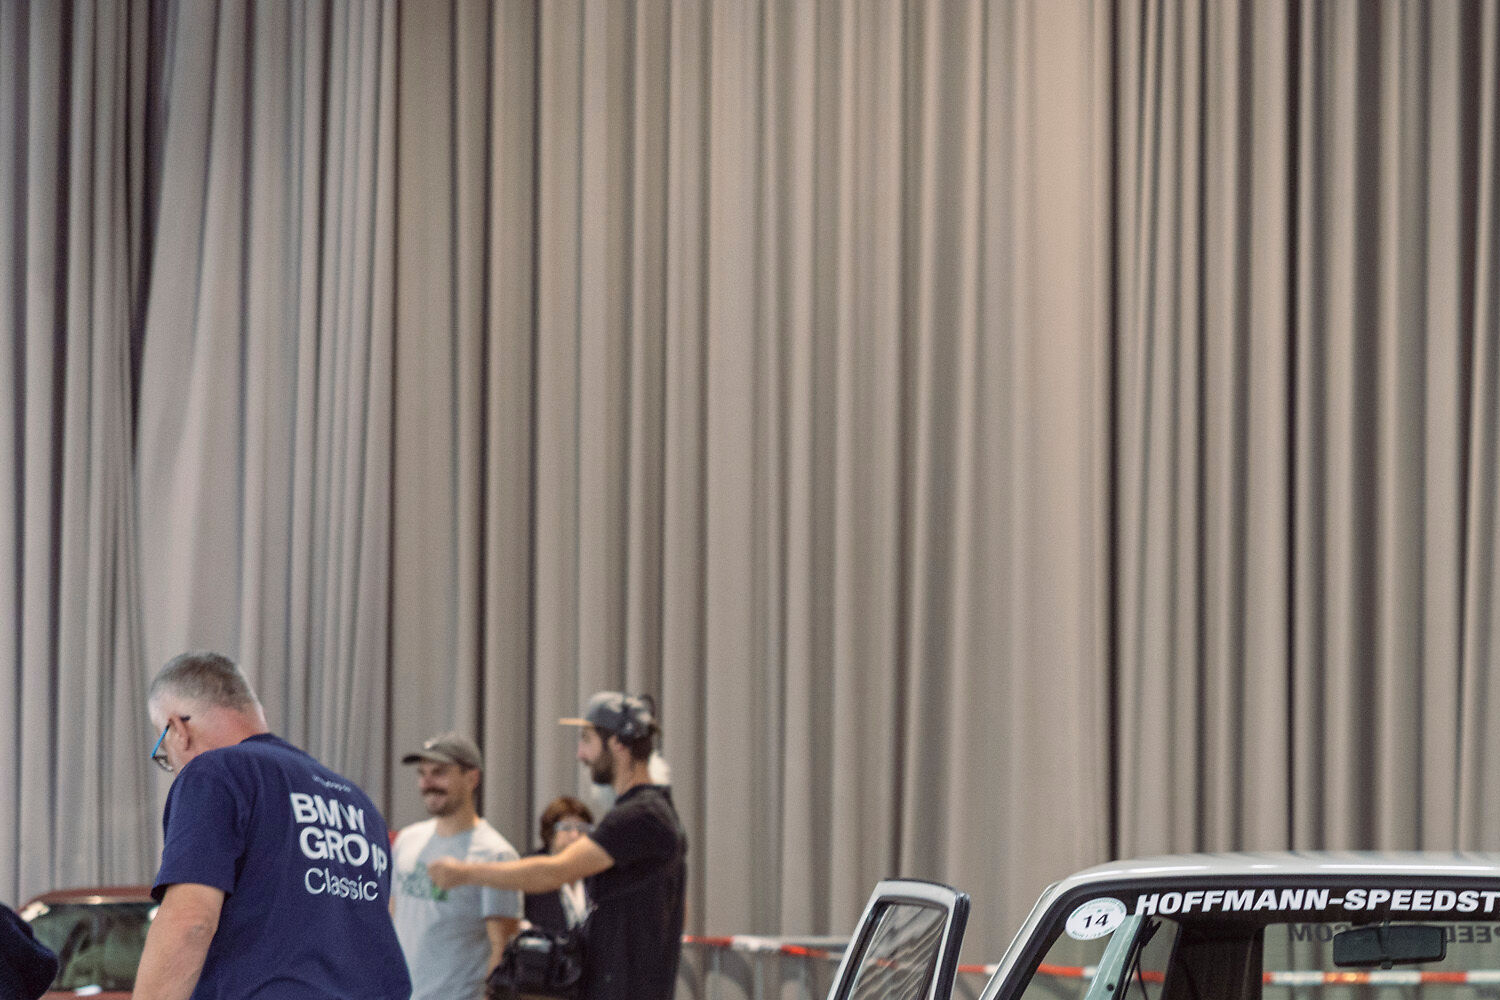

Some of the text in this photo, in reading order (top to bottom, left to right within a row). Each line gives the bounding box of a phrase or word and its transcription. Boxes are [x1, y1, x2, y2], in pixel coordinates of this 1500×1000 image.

[290, 792, 366, 834] BMW
[304, 867, 378, 901] Classic
[1083, 913, 1109, 929] 14
